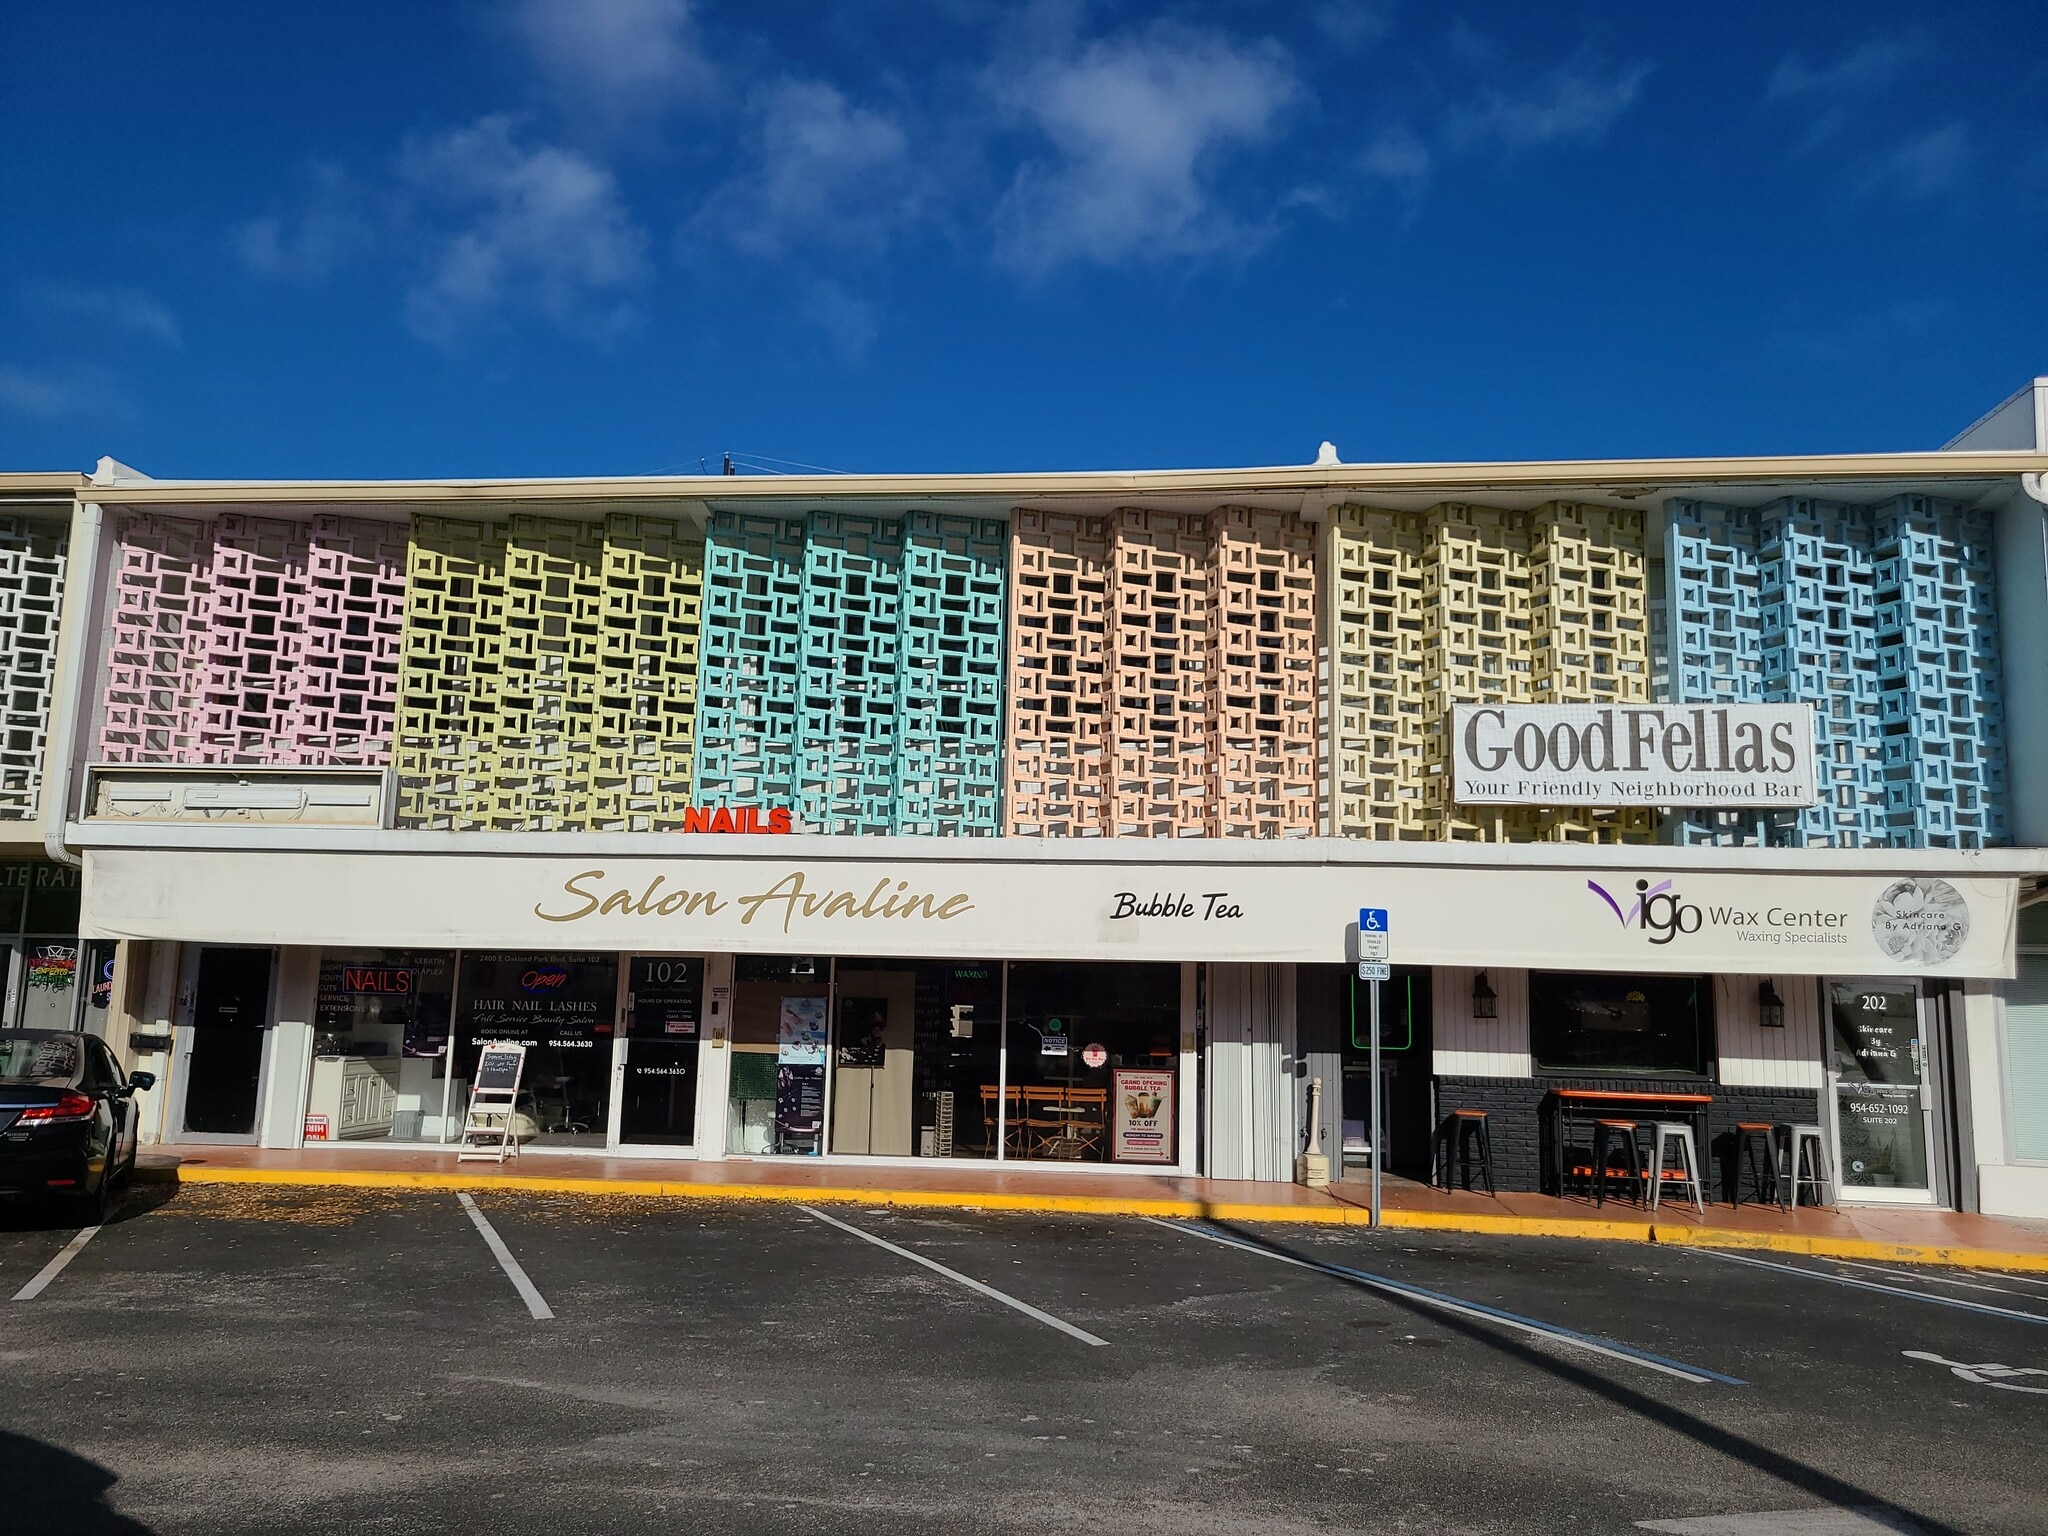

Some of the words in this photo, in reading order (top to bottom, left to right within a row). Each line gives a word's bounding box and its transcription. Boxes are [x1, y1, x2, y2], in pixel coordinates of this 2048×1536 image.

[1464, 708, 1796, 774] GoodFellas
[1463, 780, 1510, 796] Your
[1516, 780, 1602, 800] Friendly
[1609, 780, 1757, 801] Neighborhood
[1763, 782, 1803, 798] Bar
[684, 806, 792, 836] NAILS
[533, 870, 729, 923] Salon
[737, 870, 976, 934] Avaline
[1109, 891, 1196, 921] Bubble
[1199, 892, 1244, 920] Tea
[1587, 878, 1703, 945] Vigo
[1709, 906, 1760, 927] Wax
[1766, 906, 1849, 928] Center
[1895, 909, 1945, 920] Skincare
[1885, 921, 1900, 932] By
[1902, 921, 1950, 931] Adriana
[1952, 922, 1962, 931] G
[1736, 931, 1781, 944] Waxing
[1783, 931, 1848, 945] Specialists
[414, 957, 446, 965] KERATIN
[533, 955, 549, 963] Park
[412, 967, 444, 976] OLAPLEX
[645, 961, 688, 983] 102
[1376, 967, 1387, 976] FINE
[345, 969, 410, 992] NAILS
[521, 970, 567, 990] Open
[320, 1004, 365, 1012] EXTENSIONS
[473, 999, 505, 1010] HAIR
[511, 1000, 543, 1011] NAIL
[550, 1001, 597, 1012] LASHES
[1862, 995, 1887, 1010] 202
[472, 1013, 495, 1023] Full
[494, 1013, 528, 1023] Service
[528, 1014, 565, 1026] Beauty
[565, 1016, 595, 1024] Salon
[548, 1040, 593, 1048] 954.564.3630
[1850, 1103, 1909, 1114] 954-652-1092
[1884, 1117, 1897, 1125] 202
